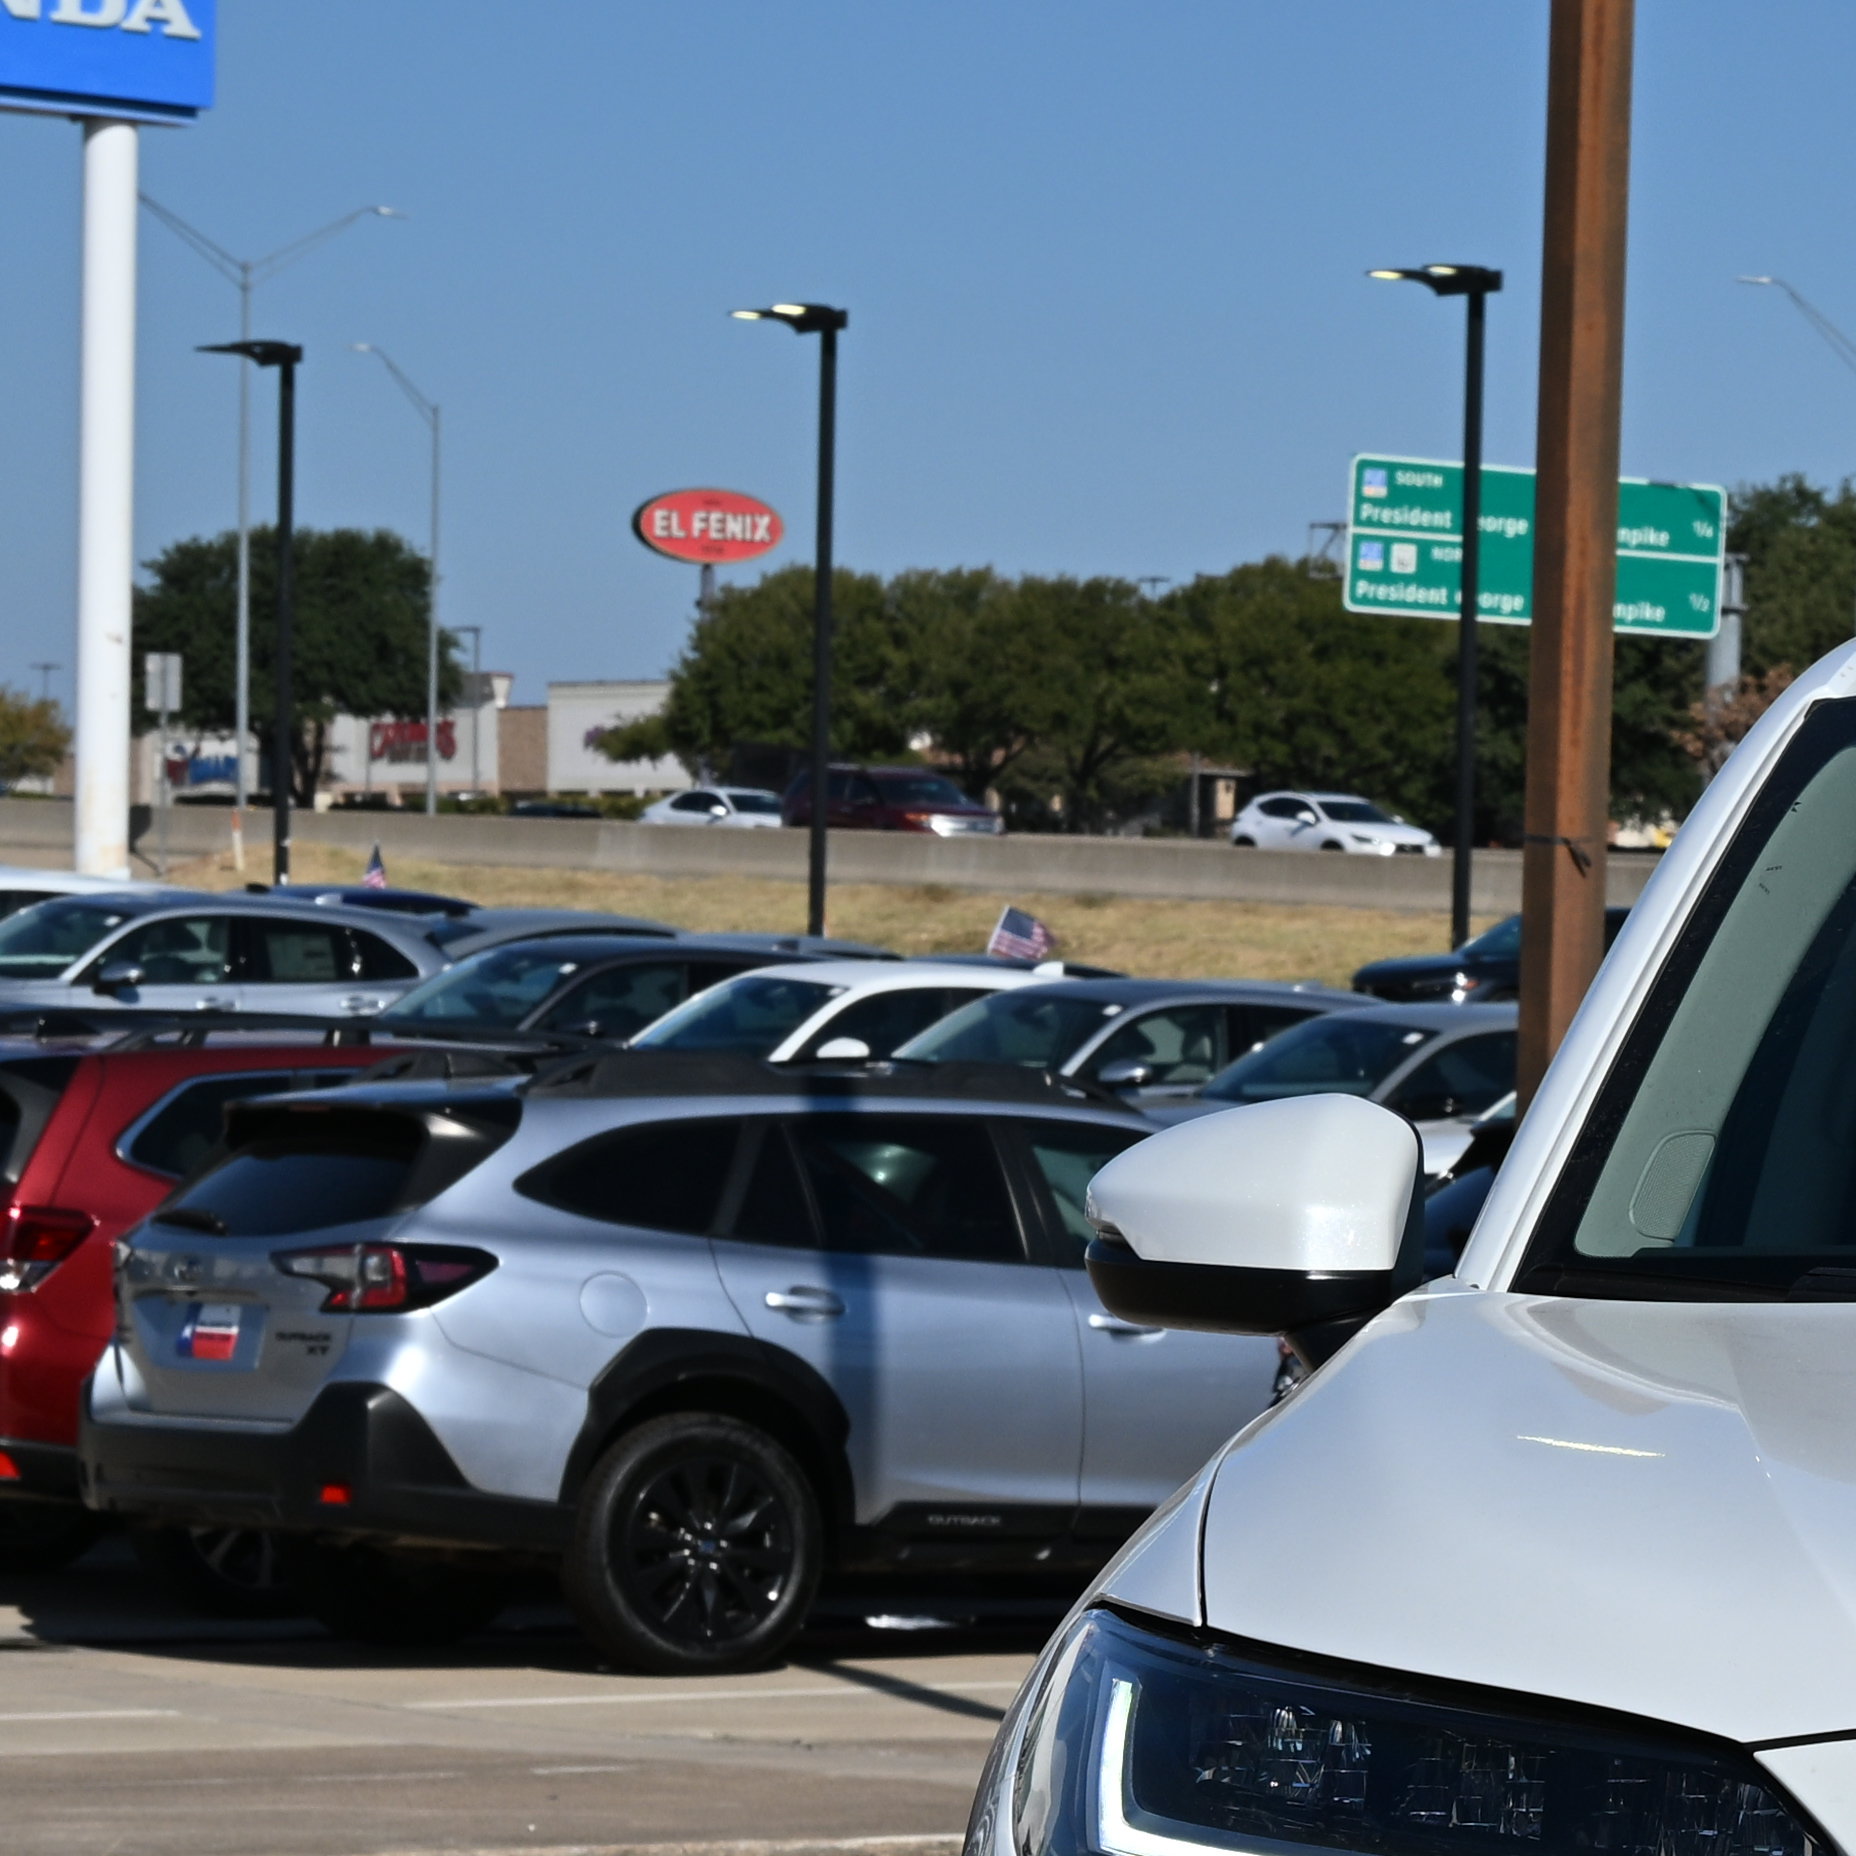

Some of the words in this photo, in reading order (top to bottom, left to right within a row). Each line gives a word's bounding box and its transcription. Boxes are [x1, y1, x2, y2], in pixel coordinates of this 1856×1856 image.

[654, 509, 686, 538] EL
[692, 511, 770, 544] FENIX
[1360, 503, 1453, 529] President
[1355, 579, 1449, 606] President
